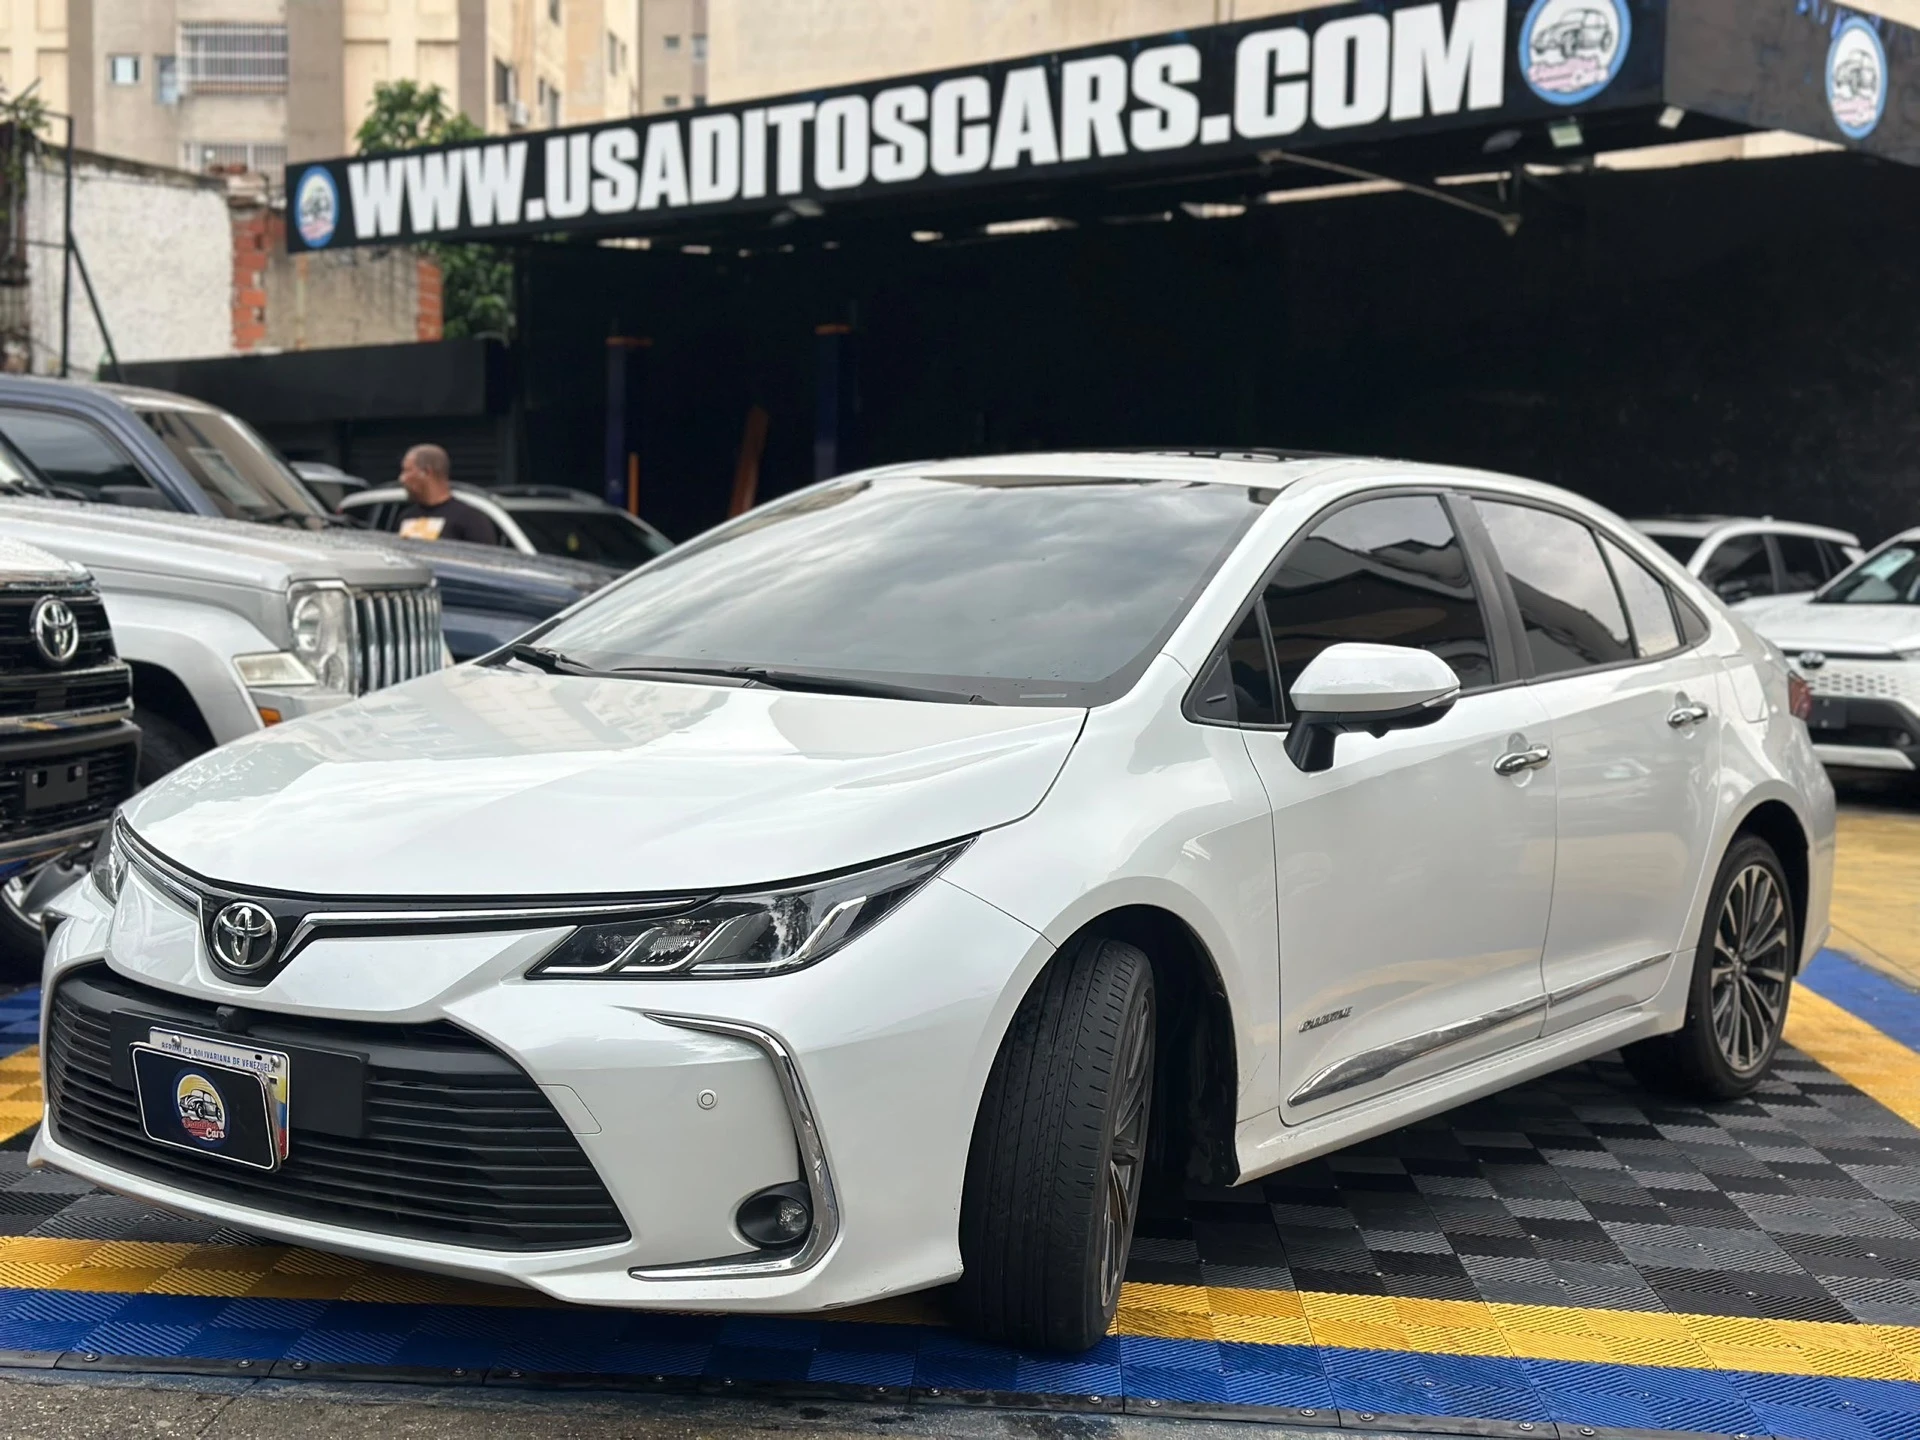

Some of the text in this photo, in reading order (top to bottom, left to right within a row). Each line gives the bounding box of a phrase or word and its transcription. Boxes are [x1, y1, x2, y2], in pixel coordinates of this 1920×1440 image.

[348, 0, 1507, 238] WWW.USADITOSCARS.COM
[232, 1057, 240, 1066] DE
[242, 1058, 276, 1073] VENEZUELA
[205, 1127, 226, 1139] Cars
